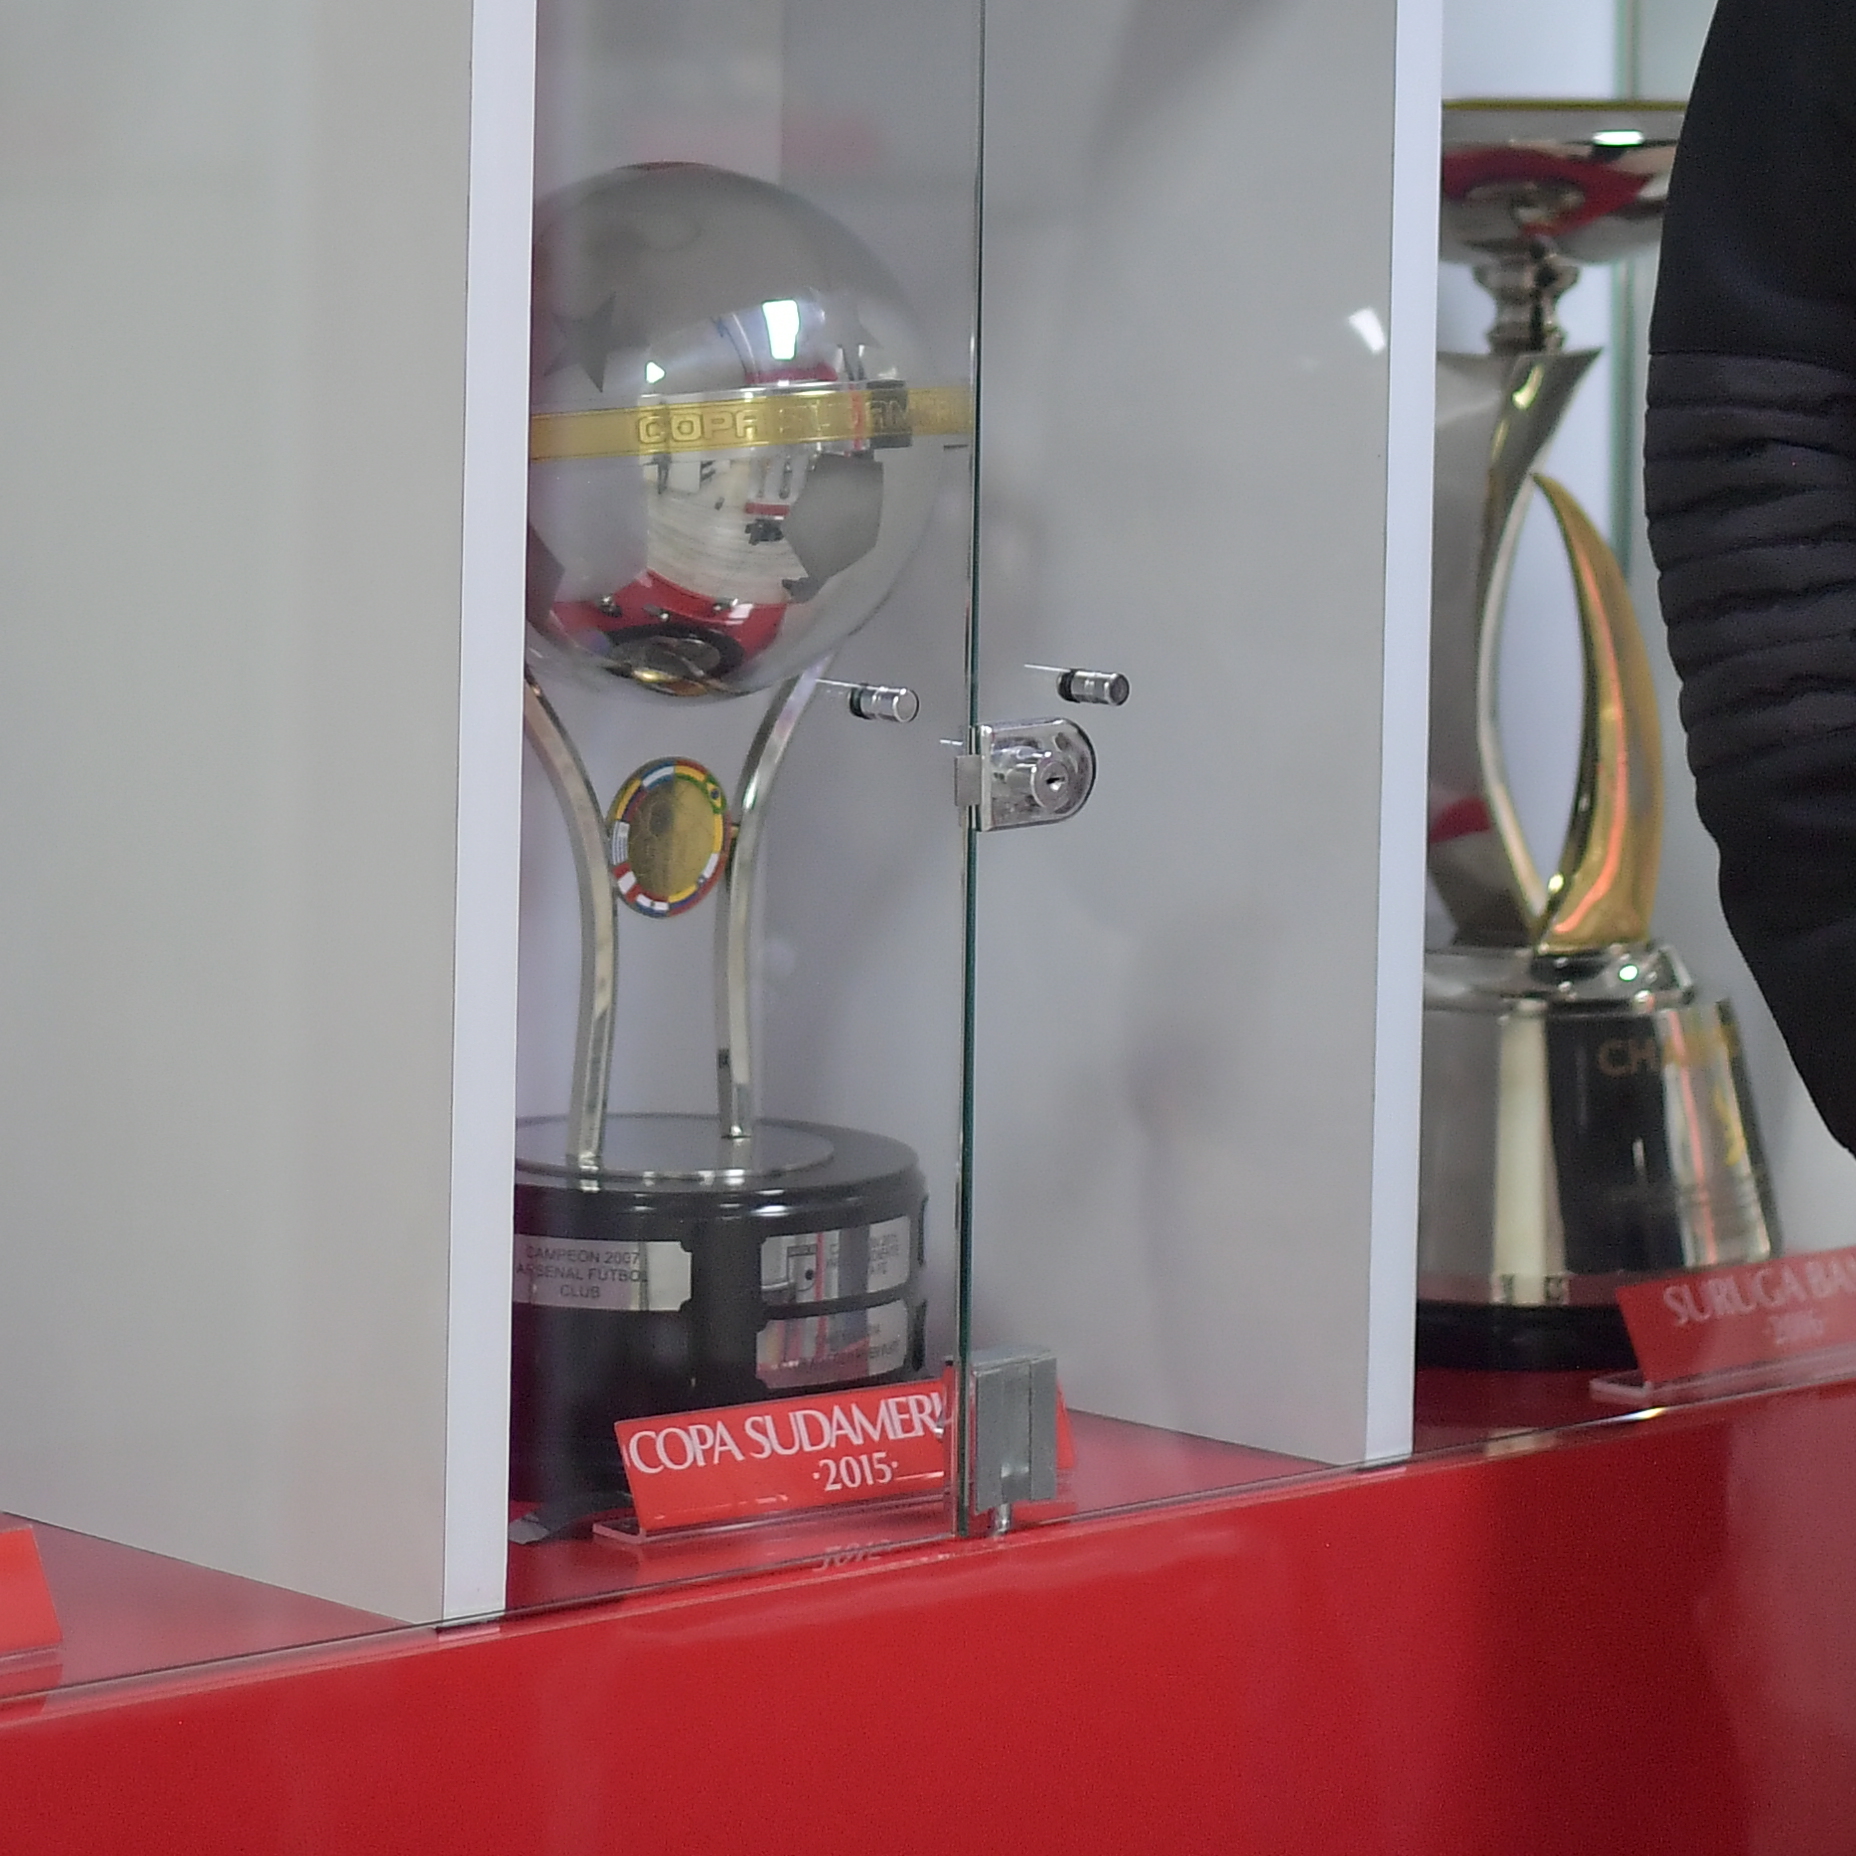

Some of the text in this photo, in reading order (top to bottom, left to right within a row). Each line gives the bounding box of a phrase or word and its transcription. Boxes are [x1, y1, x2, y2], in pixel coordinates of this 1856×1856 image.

[636, 408, 759, 446] COPA
[516, 1262, 585, 1282] ARSENAL
[559, 1283, 601, 1300] CLUB
[628, 1419, 745, 1475] COPA
